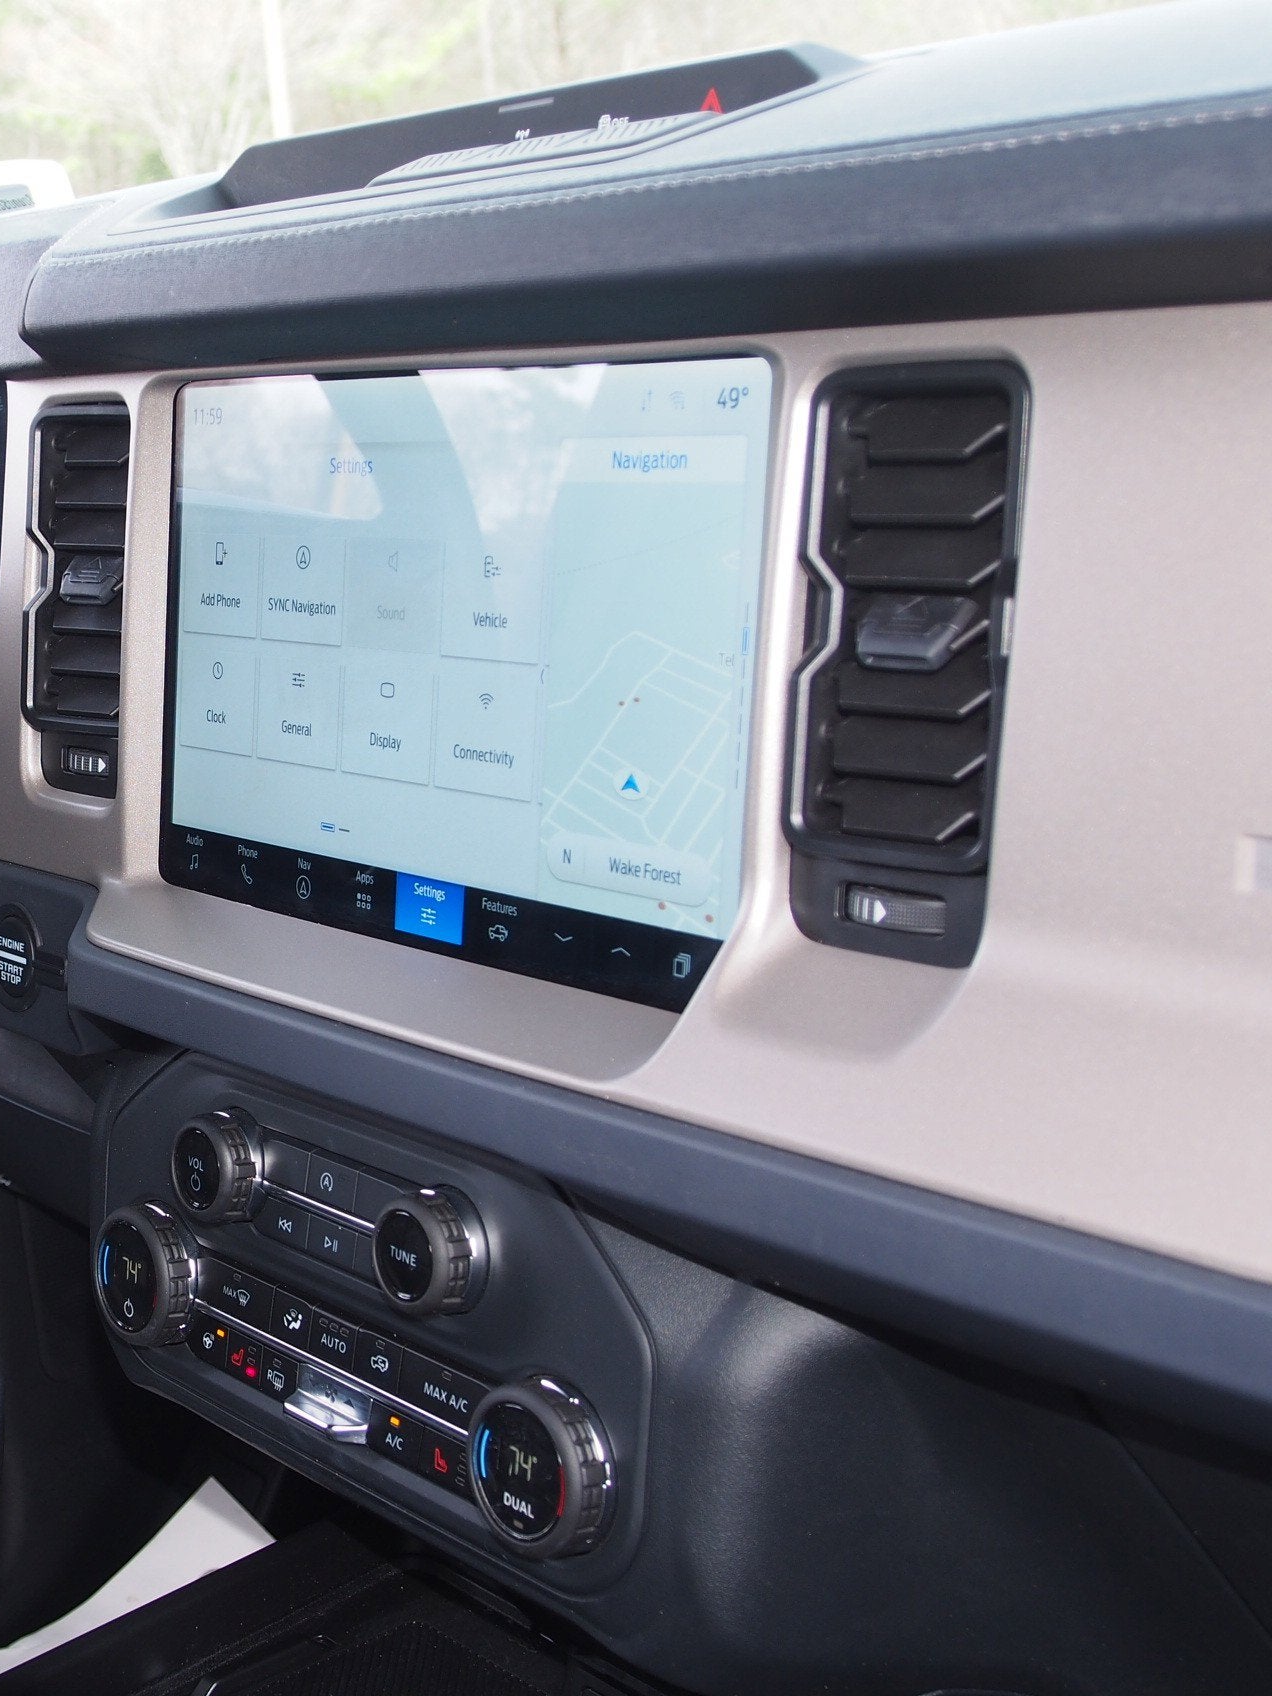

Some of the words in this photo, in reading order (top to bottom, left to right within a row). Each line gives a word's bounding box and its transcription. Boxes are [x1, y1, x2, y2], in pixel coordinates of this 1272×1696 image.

[192, 407, 224, 426] 11:59
[329, 457, 374, 477] Settings
[611, 450, 689, 474] Navigation
[200, 592, 216, 607] Add
[216, 593, 241, 609] Phone
[268, 597, 290, 613] SYNC
[291, 598, 336, 617] Navigation
[377, 604, 405, 621] Sound
[472, 611, 508, 629] Vehicle
[206, 709, 227, 725] Clock
[281, 719, 313, 737] General
[369, 732, 402, 752] Display
[453, 743, 515, 769] Connectivity
[186, 833, 204, 848] Audio
[237, 844, 259, 860] Phone
[562, 848, 572, 864] N
[297, 856, 312, 871] Nav
[609, 856, 642, 879] Wake
[643, 862, 682, 886] Forest
[355, 869, 375, 885] Apps
[413, 882, 446, 902] Settings
[481, 897, 518, 917] Features
[0, 970, 22, 986] STOP
[188, 1154, 204, 1173] VOL
[389, 1245, 417, 1268] TUNE
[222, 1285, 237, 1299] MAX
[320, 1333, 347, 1354] AUTO
[423, 1381, 447, 1406] MAX
[449, 1389, 469, 1414] A/C
[385, 1432, 404, 1451] A/C
[503, 1490, 536, 1519] DUAL
